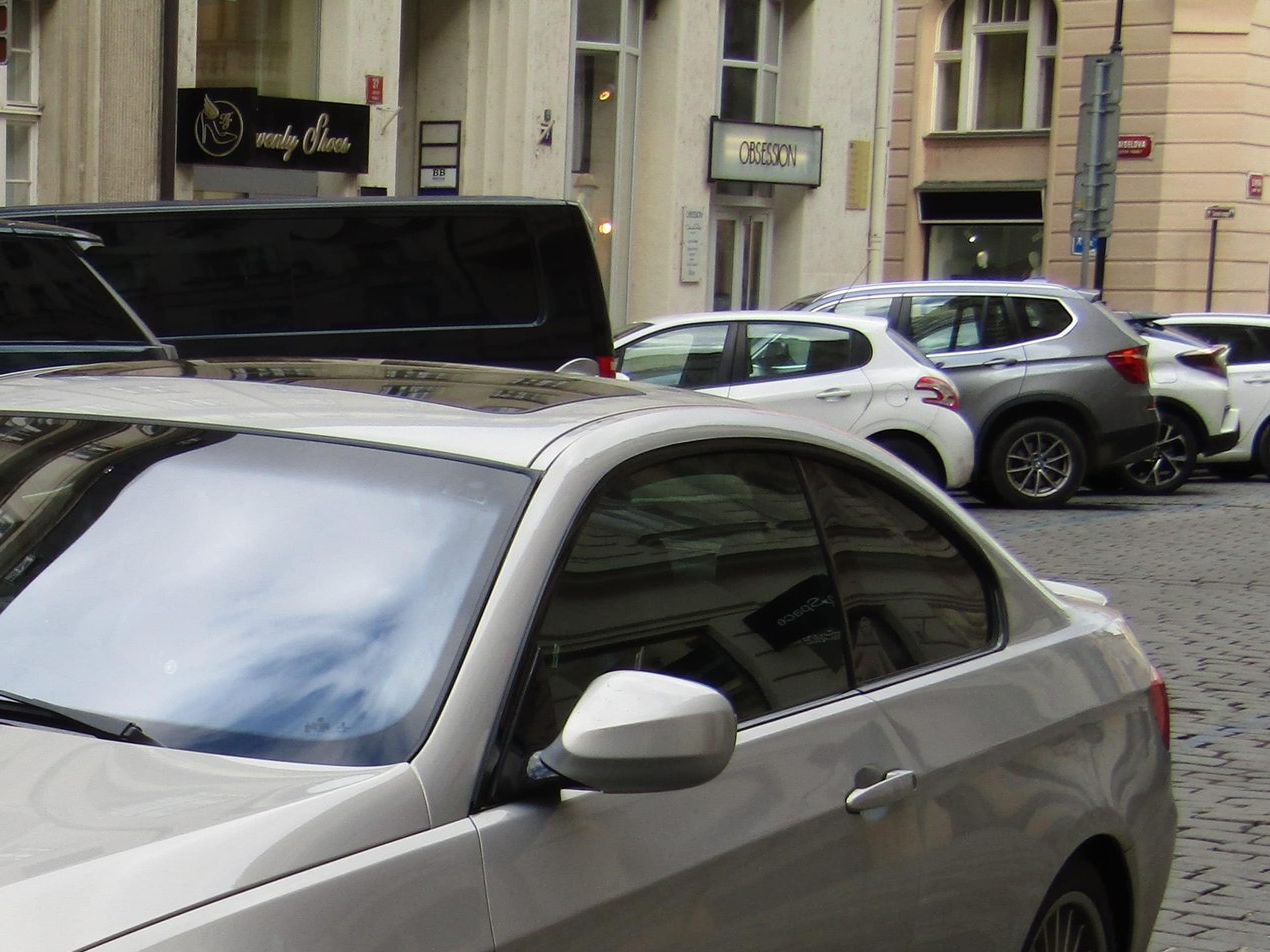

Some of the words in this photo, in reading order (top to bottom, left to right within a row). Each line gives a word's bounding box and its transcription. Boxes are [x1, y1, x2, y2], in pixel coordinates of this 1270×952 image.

[302, 112, 352, 155] Shoes
[738, 140, 798, 168] OBSESSION
[432, 168, 446, 177] BB
